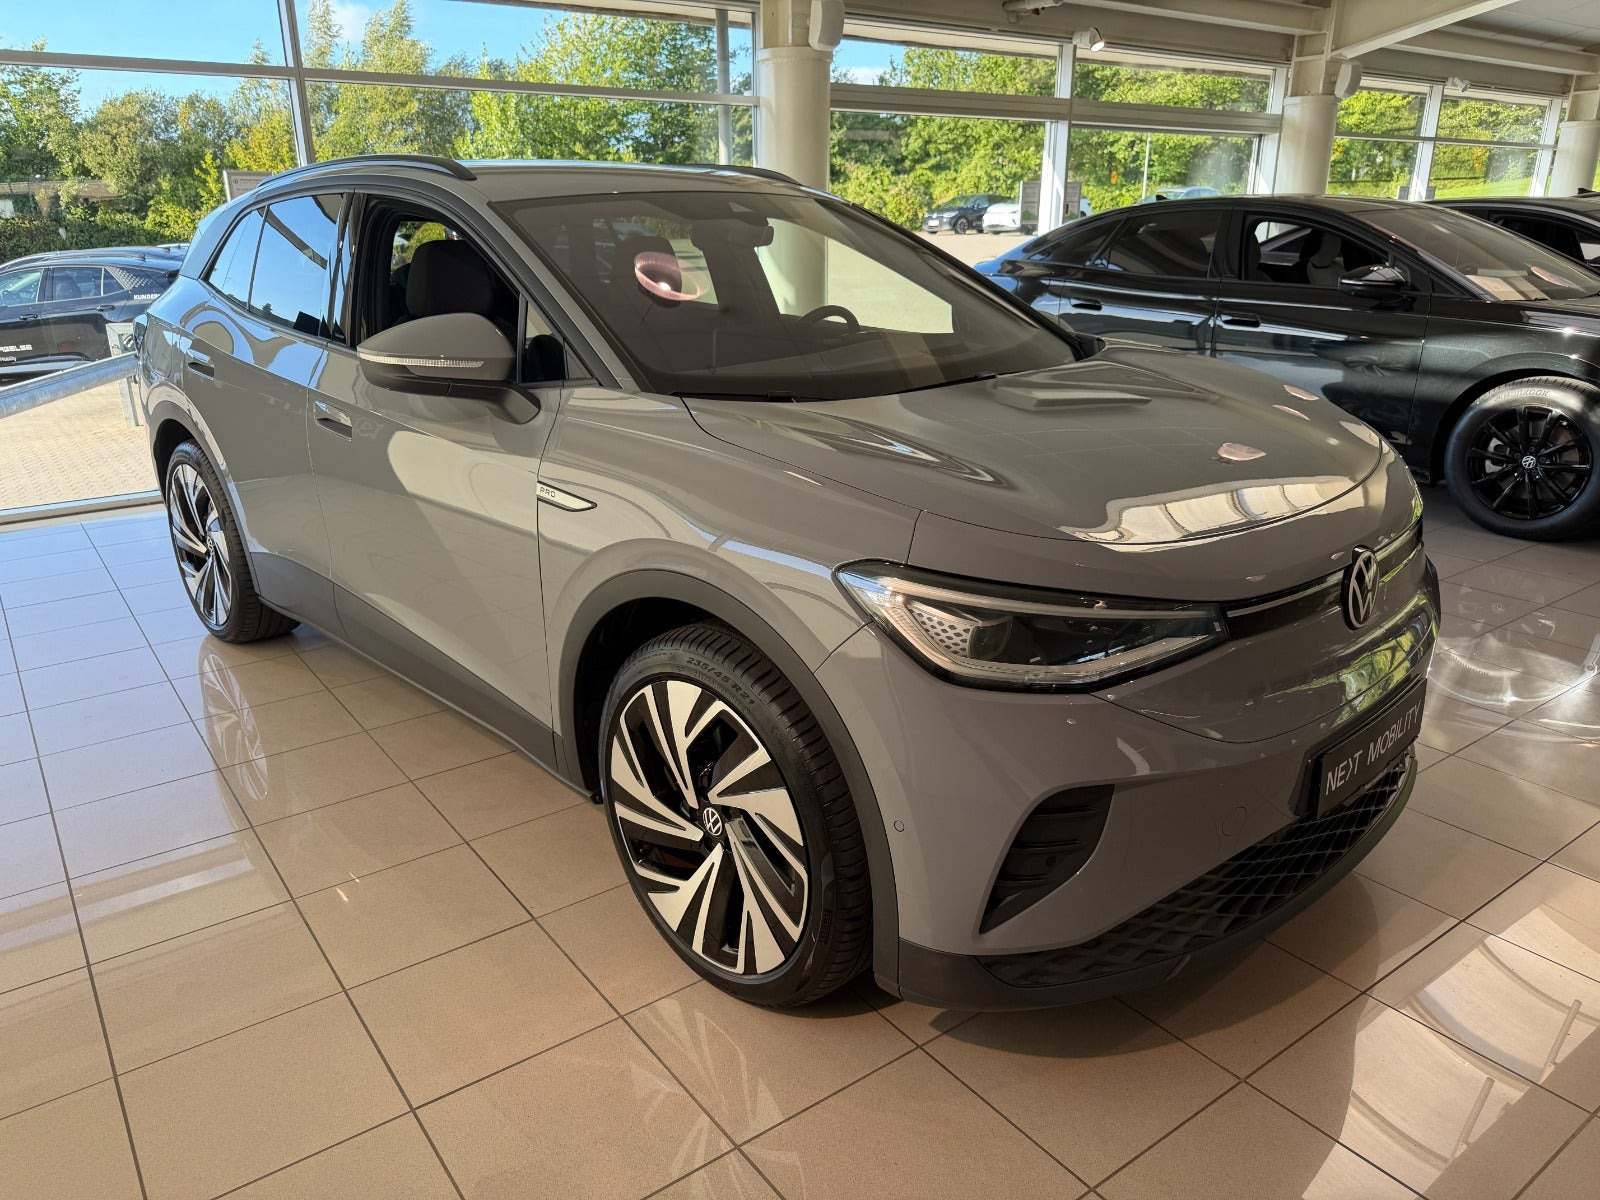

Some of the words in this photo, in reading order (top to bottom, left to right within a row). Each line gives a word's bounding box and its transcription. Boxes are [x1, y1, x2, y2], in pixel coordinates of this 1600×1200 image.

[539, 486, 556, 498] PRO
[1325, 748, 1364, 797] NEXT
[1366, 700, 1422, 767] MOBILITY
